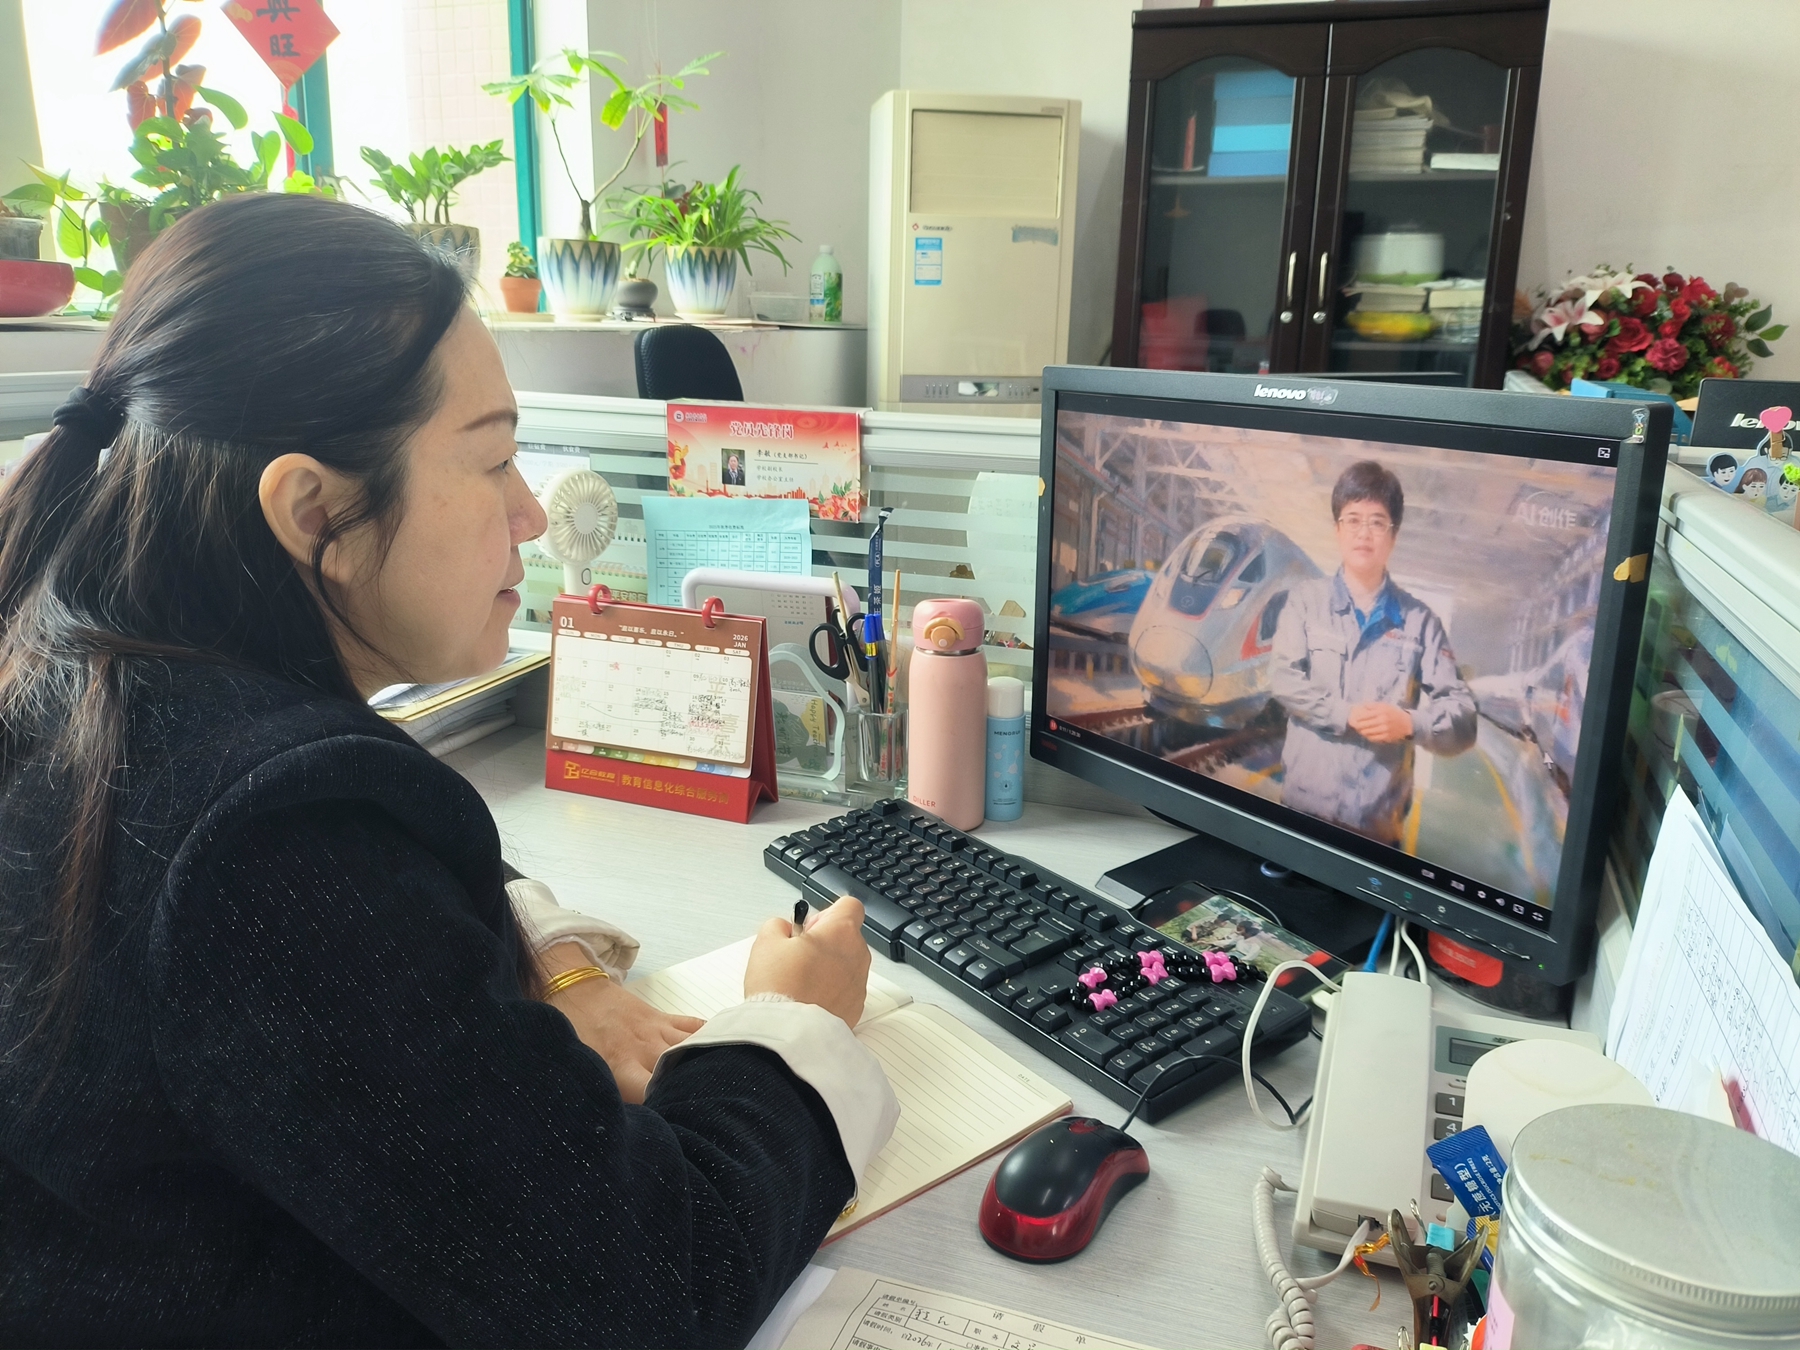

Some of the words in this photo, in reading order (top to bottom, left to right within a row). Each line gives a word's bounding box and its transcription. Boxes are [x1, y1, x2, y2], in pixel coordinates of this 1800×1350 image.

[1254, 384, 1306, 400] lenovo
[1730, 413, 1800, 430] leo
[730, 422, 793, 439] 党员先锋岗
[560, 616, 574, 628] 01
[732, 634, 749, 642] 2026
[809, 699, 819, 723] Happy
[621, 774, 729, 805] 教育信息化综合服务商
[1018, 1073, 1030, 1082] DATE
